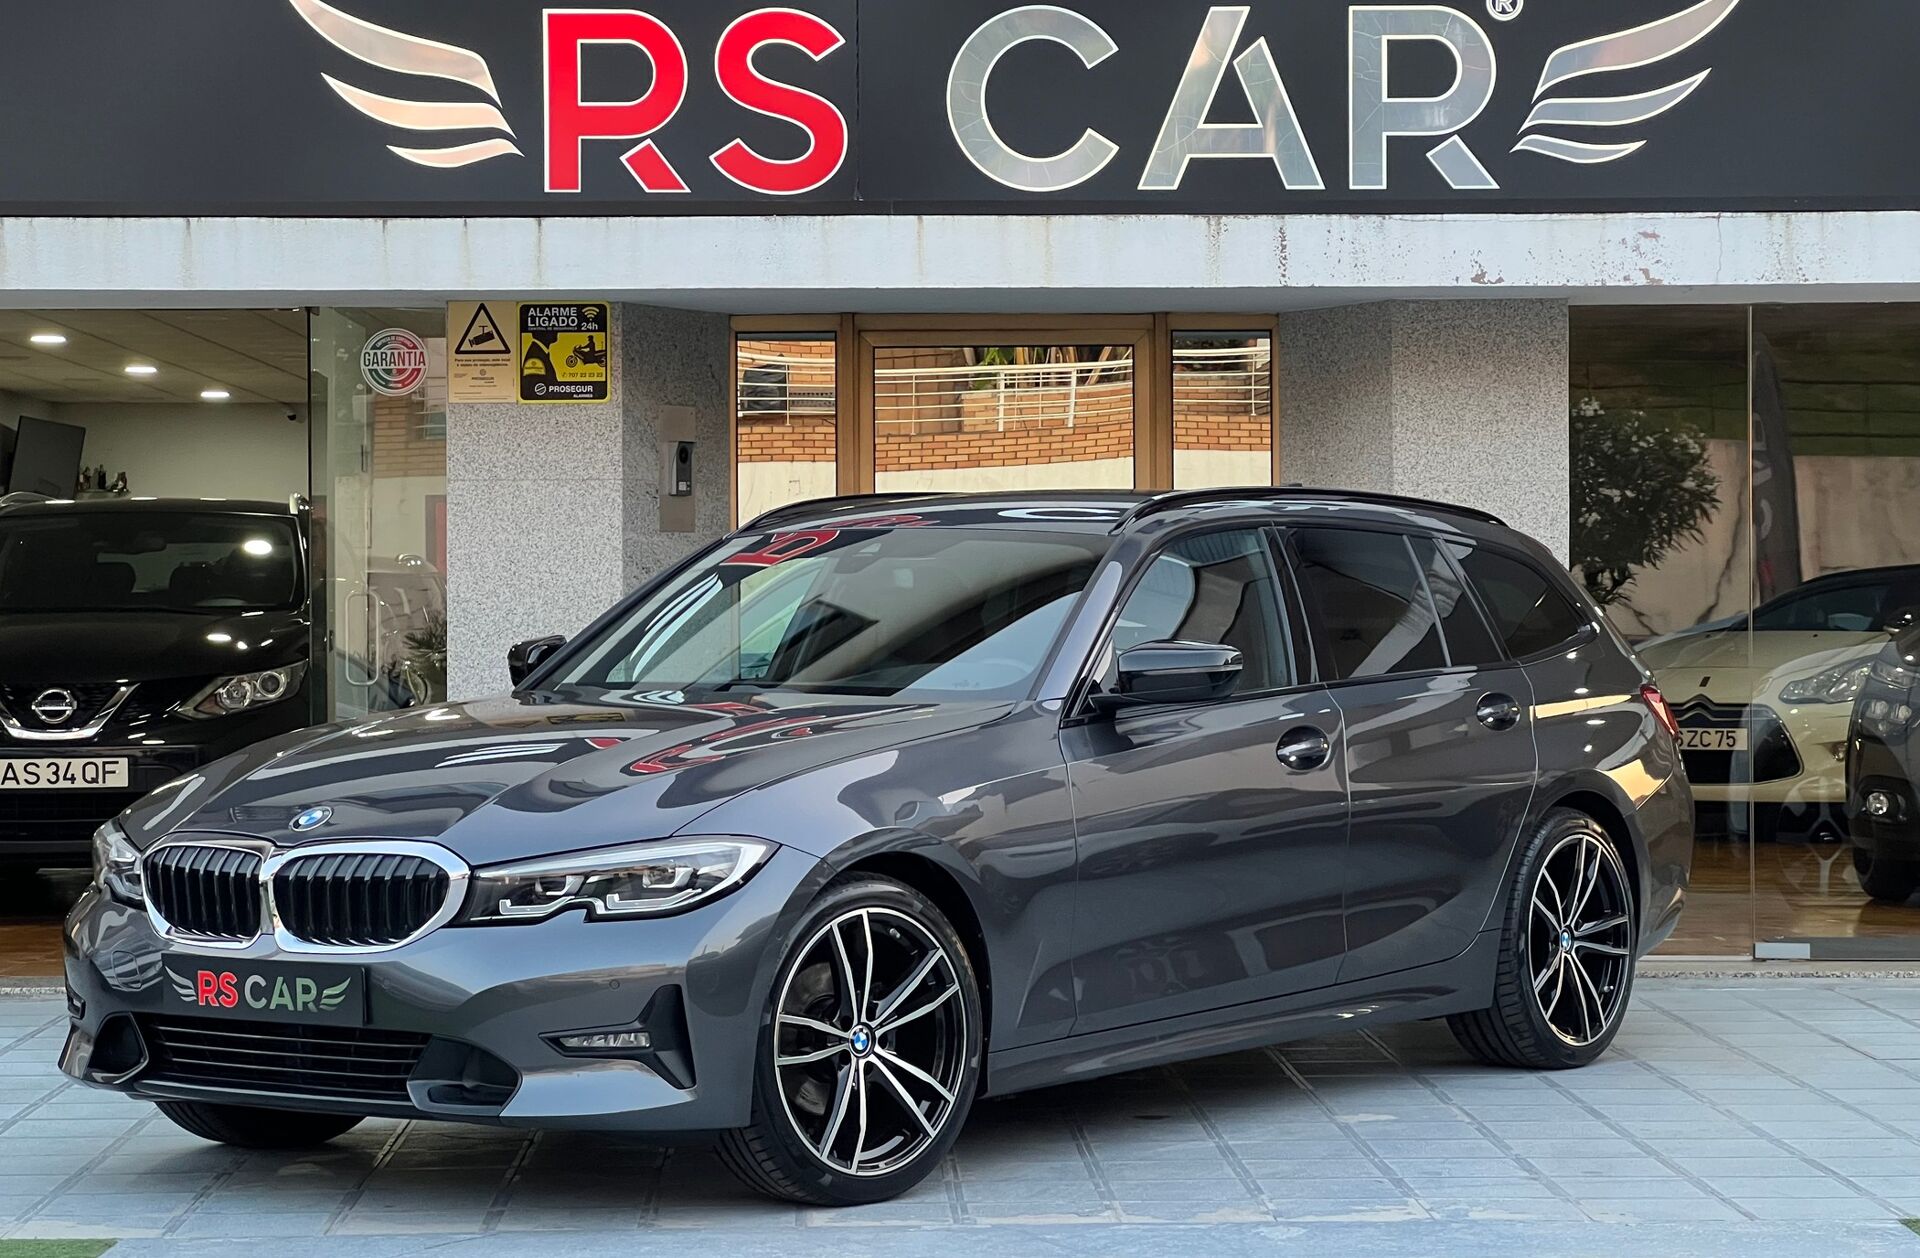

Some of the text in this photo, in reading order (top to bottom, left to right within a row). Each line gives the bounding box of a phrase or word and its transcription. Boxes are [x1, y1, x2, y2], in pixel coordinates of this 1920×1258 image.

[542, 7, 848, 195] RS
[946, 4, 1500, 192] CAR
[528, 307, 578, 317] ALARME
[527, 316, 599, 331] LIGADO 24h
[363, 351, 426, 367] GARANTIA
[197, 970, 319, 1013] RS CAR
